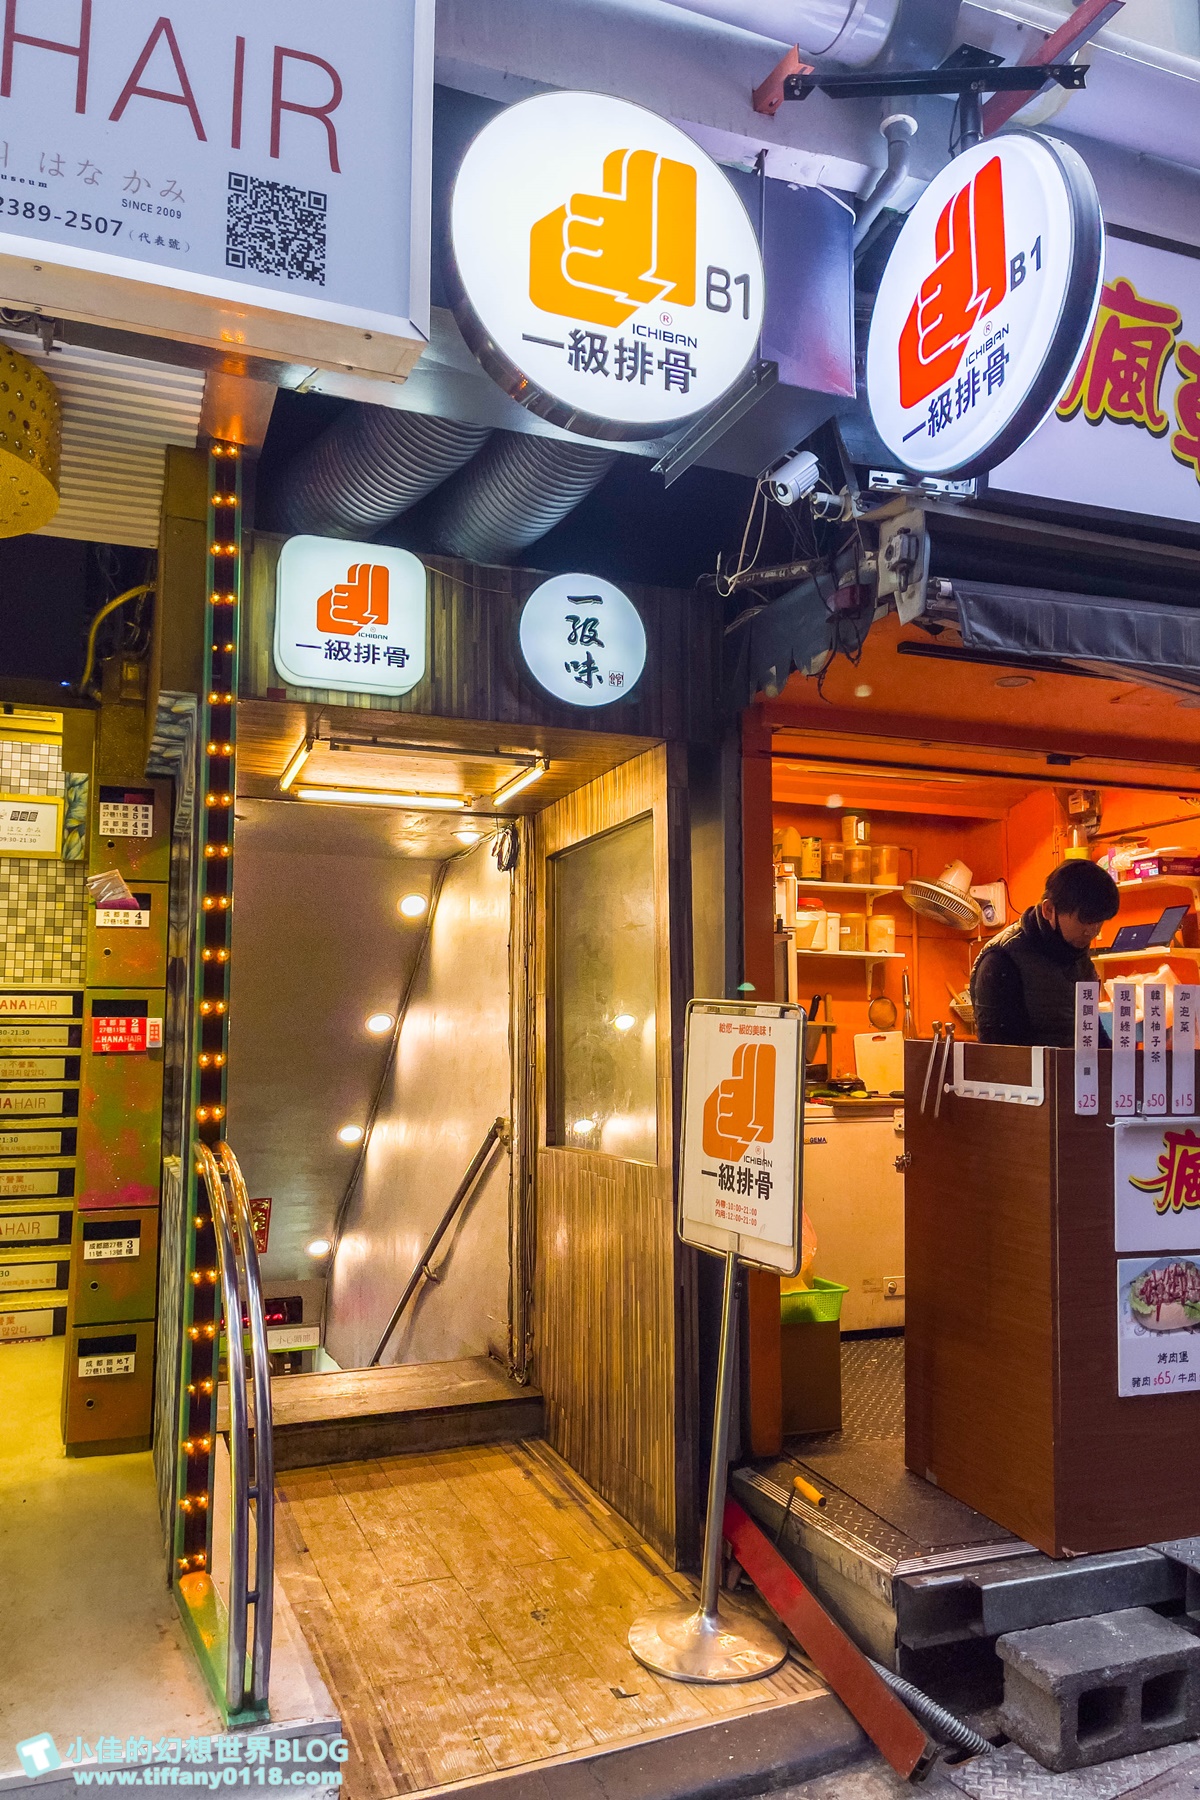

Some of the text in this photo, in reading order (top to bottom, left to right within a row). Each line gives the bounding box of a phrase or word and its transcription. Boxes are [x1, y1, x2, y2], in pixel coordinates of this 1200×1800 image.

[0, 0, 342, 174] HAIR
[0, 196, 124, 237] 389-2507
[121, 198, 182, 220] SINCE 2009
[1010, 235, 1042, 292] B1
[706, 264, 750, 320] B1
[632, 323, 698, 349] ICHIBAN
[965, 323, 1010, 368] ICHIBAN
[522, 328, 697, 394] 一級排骨
[902, 343, 1010, 443] 一級排骨
[358, 632, 389, 640] ICHIBAN
[295, 639, 410, 669] 一級排骨
[1082, 989, 1093, 1047] 現調紅茶
[1150, 990, 1161, 1063] 韓式柚子茶
[1179, 991, 1190, 1032] 加泡菜
[0, 1098, 46, 1109] AHAIR
[1078, 1094, 1097, 1108] $25
[1115, 1094, 1133, 1108] $25
[1147, 1093, 1165, 1108] $50
[1175, 1094, 1193, 1107] $15
[743, 1155, 773, 1168] ICHIBAN
[701, 1163, 773, 1200] 一級排骨
[1157, 1351, 1189, 1364] 烤肉堡
[1178, 1372, 1197, 1383] 牛肉
